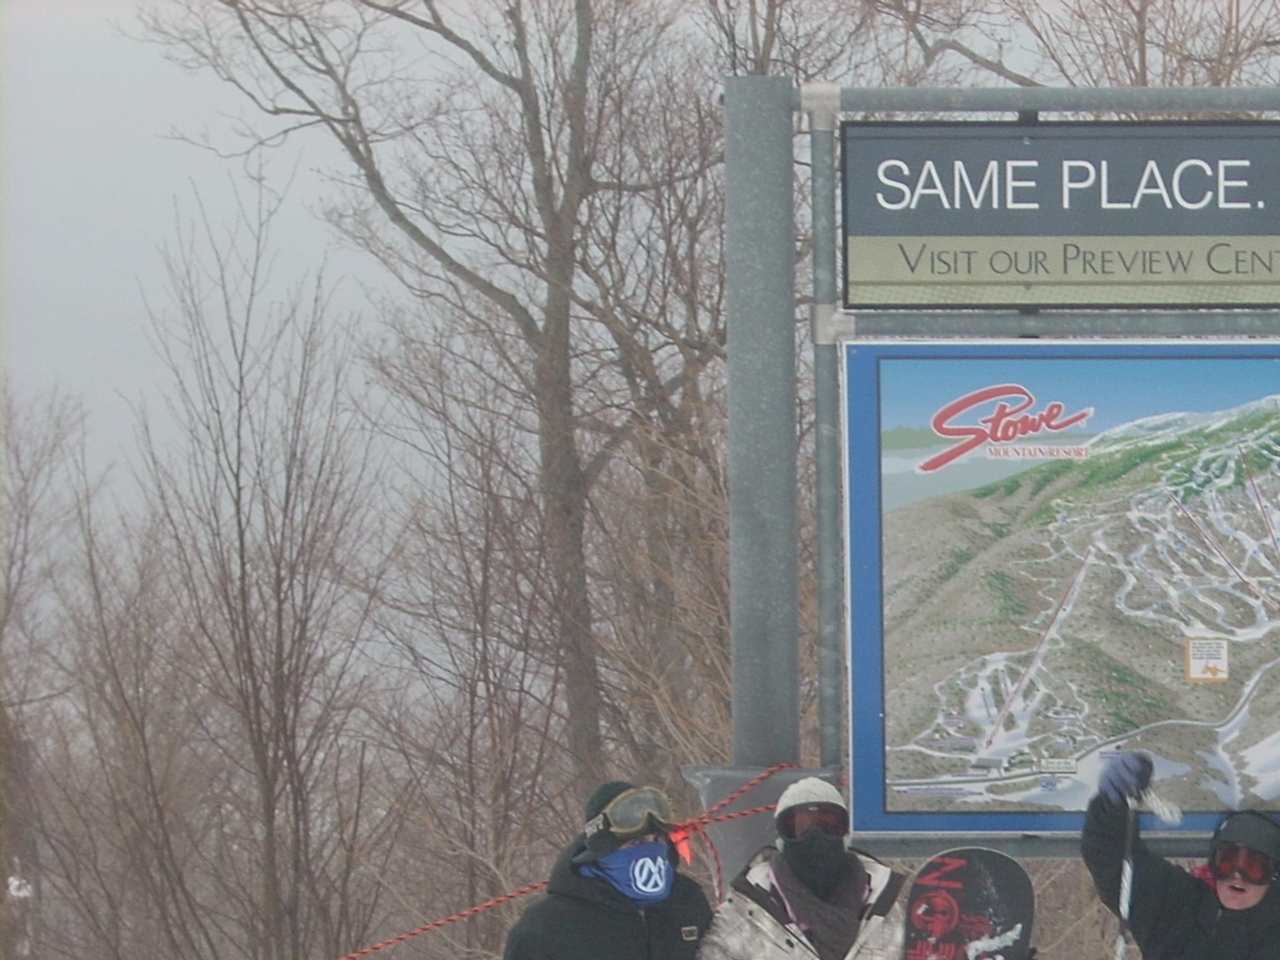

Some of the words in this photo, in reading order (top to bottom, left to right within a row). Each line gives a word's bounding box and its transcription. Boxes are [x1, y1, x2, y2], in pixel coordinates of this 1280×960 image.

[875, 159, 1039, 211] SAME
[1061, 158, 1266, 211] PLACE.
[898, 243, 978, 275] VISIT
[988, 249, 1050, 275] OUR
[1061, 243, 1194, 275] PREVIEW
[916, 384, 1094, 472] Stowe
[988, 446, 1044, 458] MOUNTAIN
